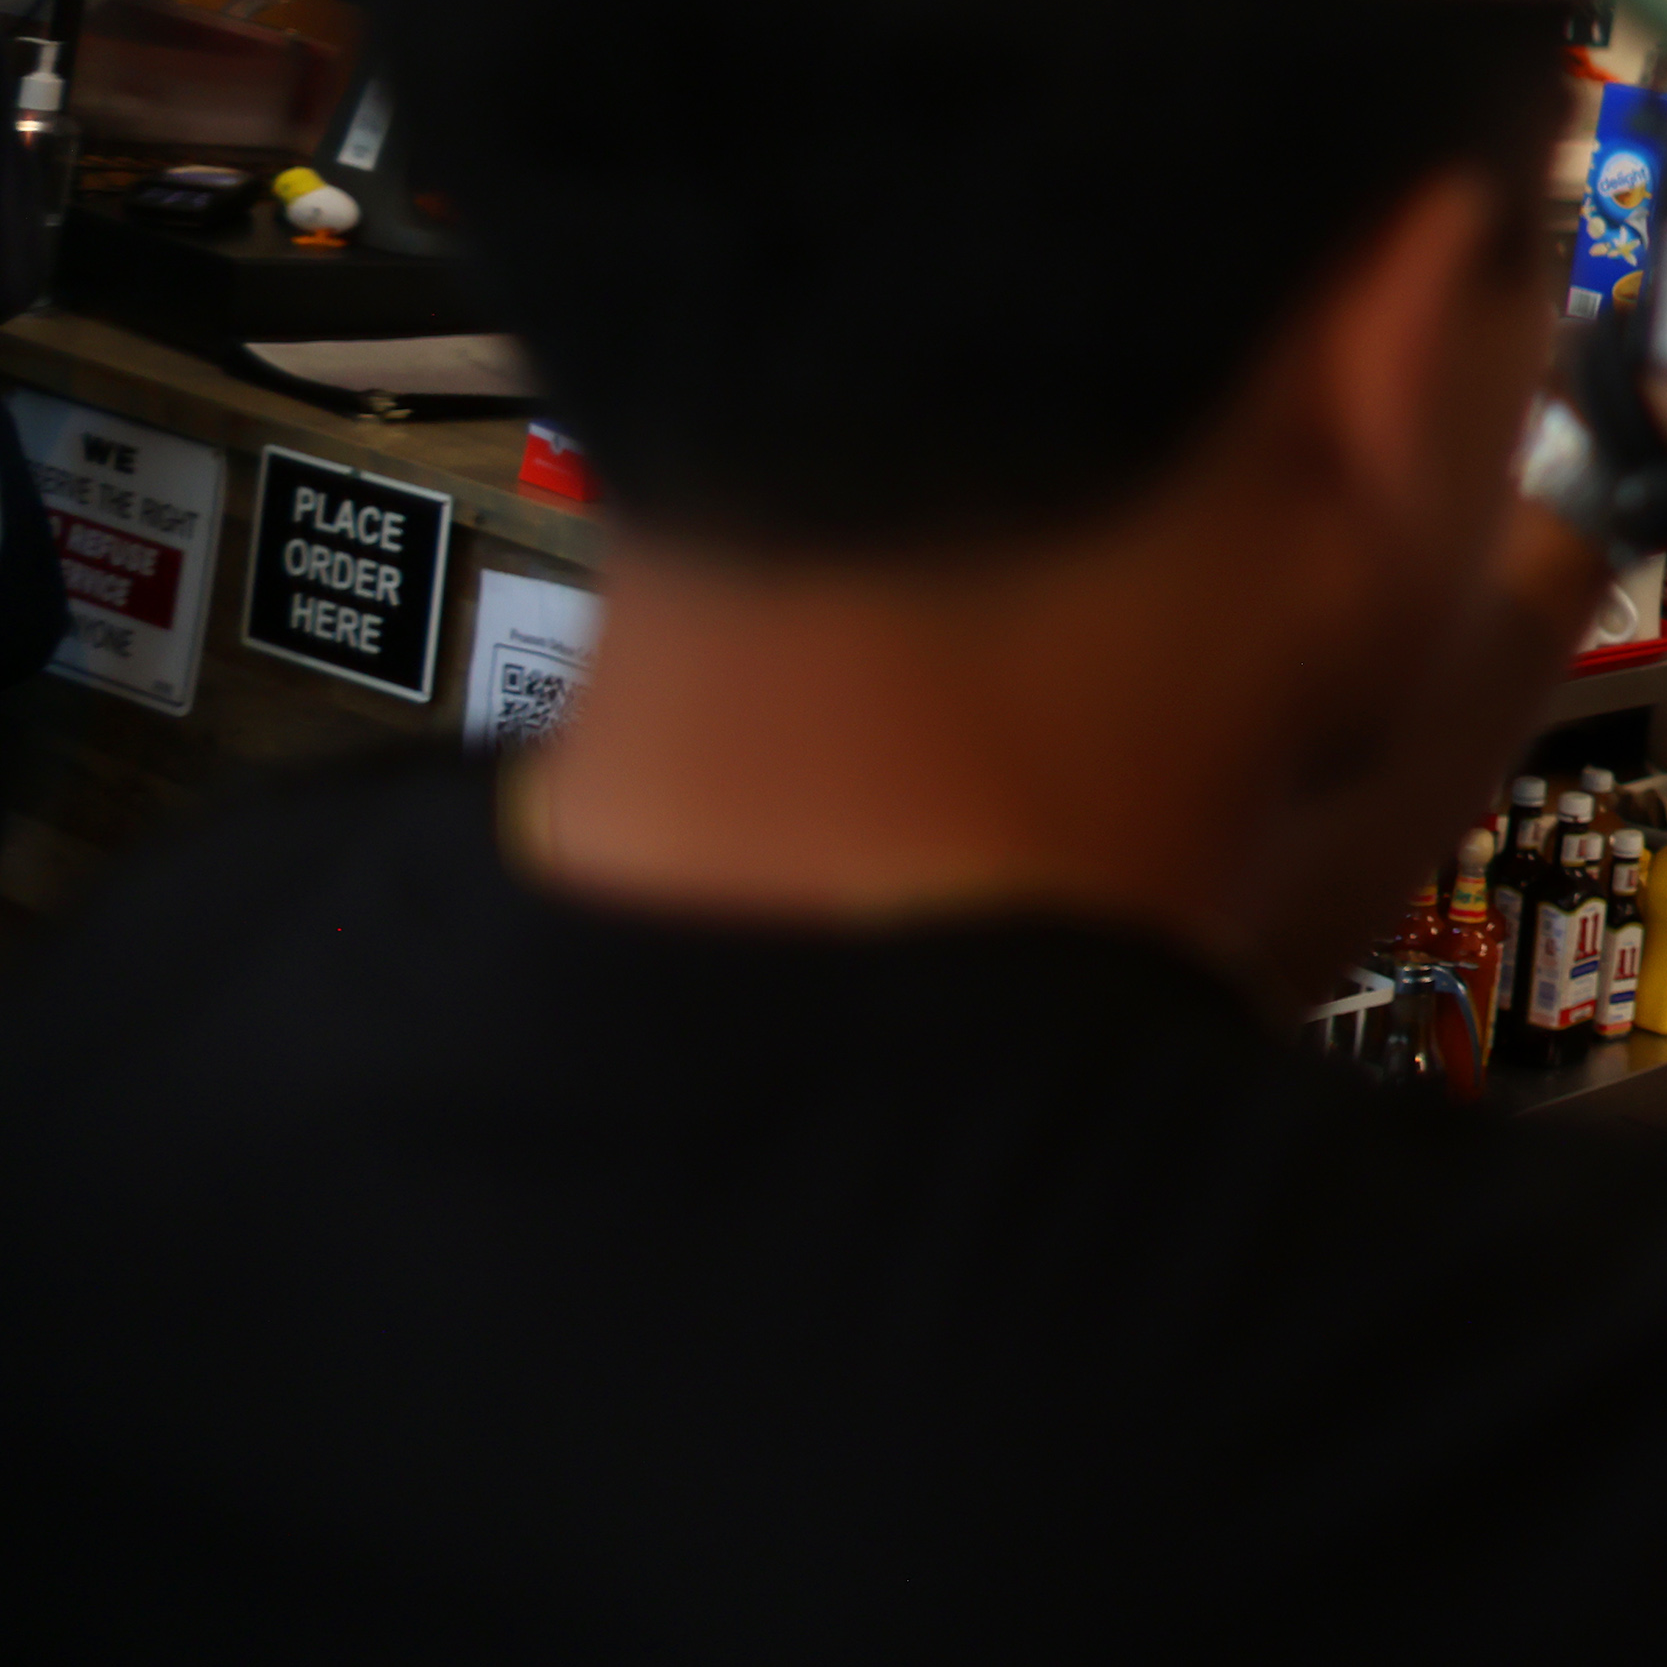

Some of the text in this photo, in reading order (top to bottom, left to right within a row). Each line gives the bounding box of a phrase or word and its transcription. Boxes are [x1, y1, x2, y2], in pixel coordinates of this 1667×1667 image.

[1600, 168, 1650, 191] delight
[83, 434, 139, 475] WE
[293, 485, 406, 554] PLACE
[284, 537, 402, 607] ORDER
[290, 592, 383, 655] HERE
